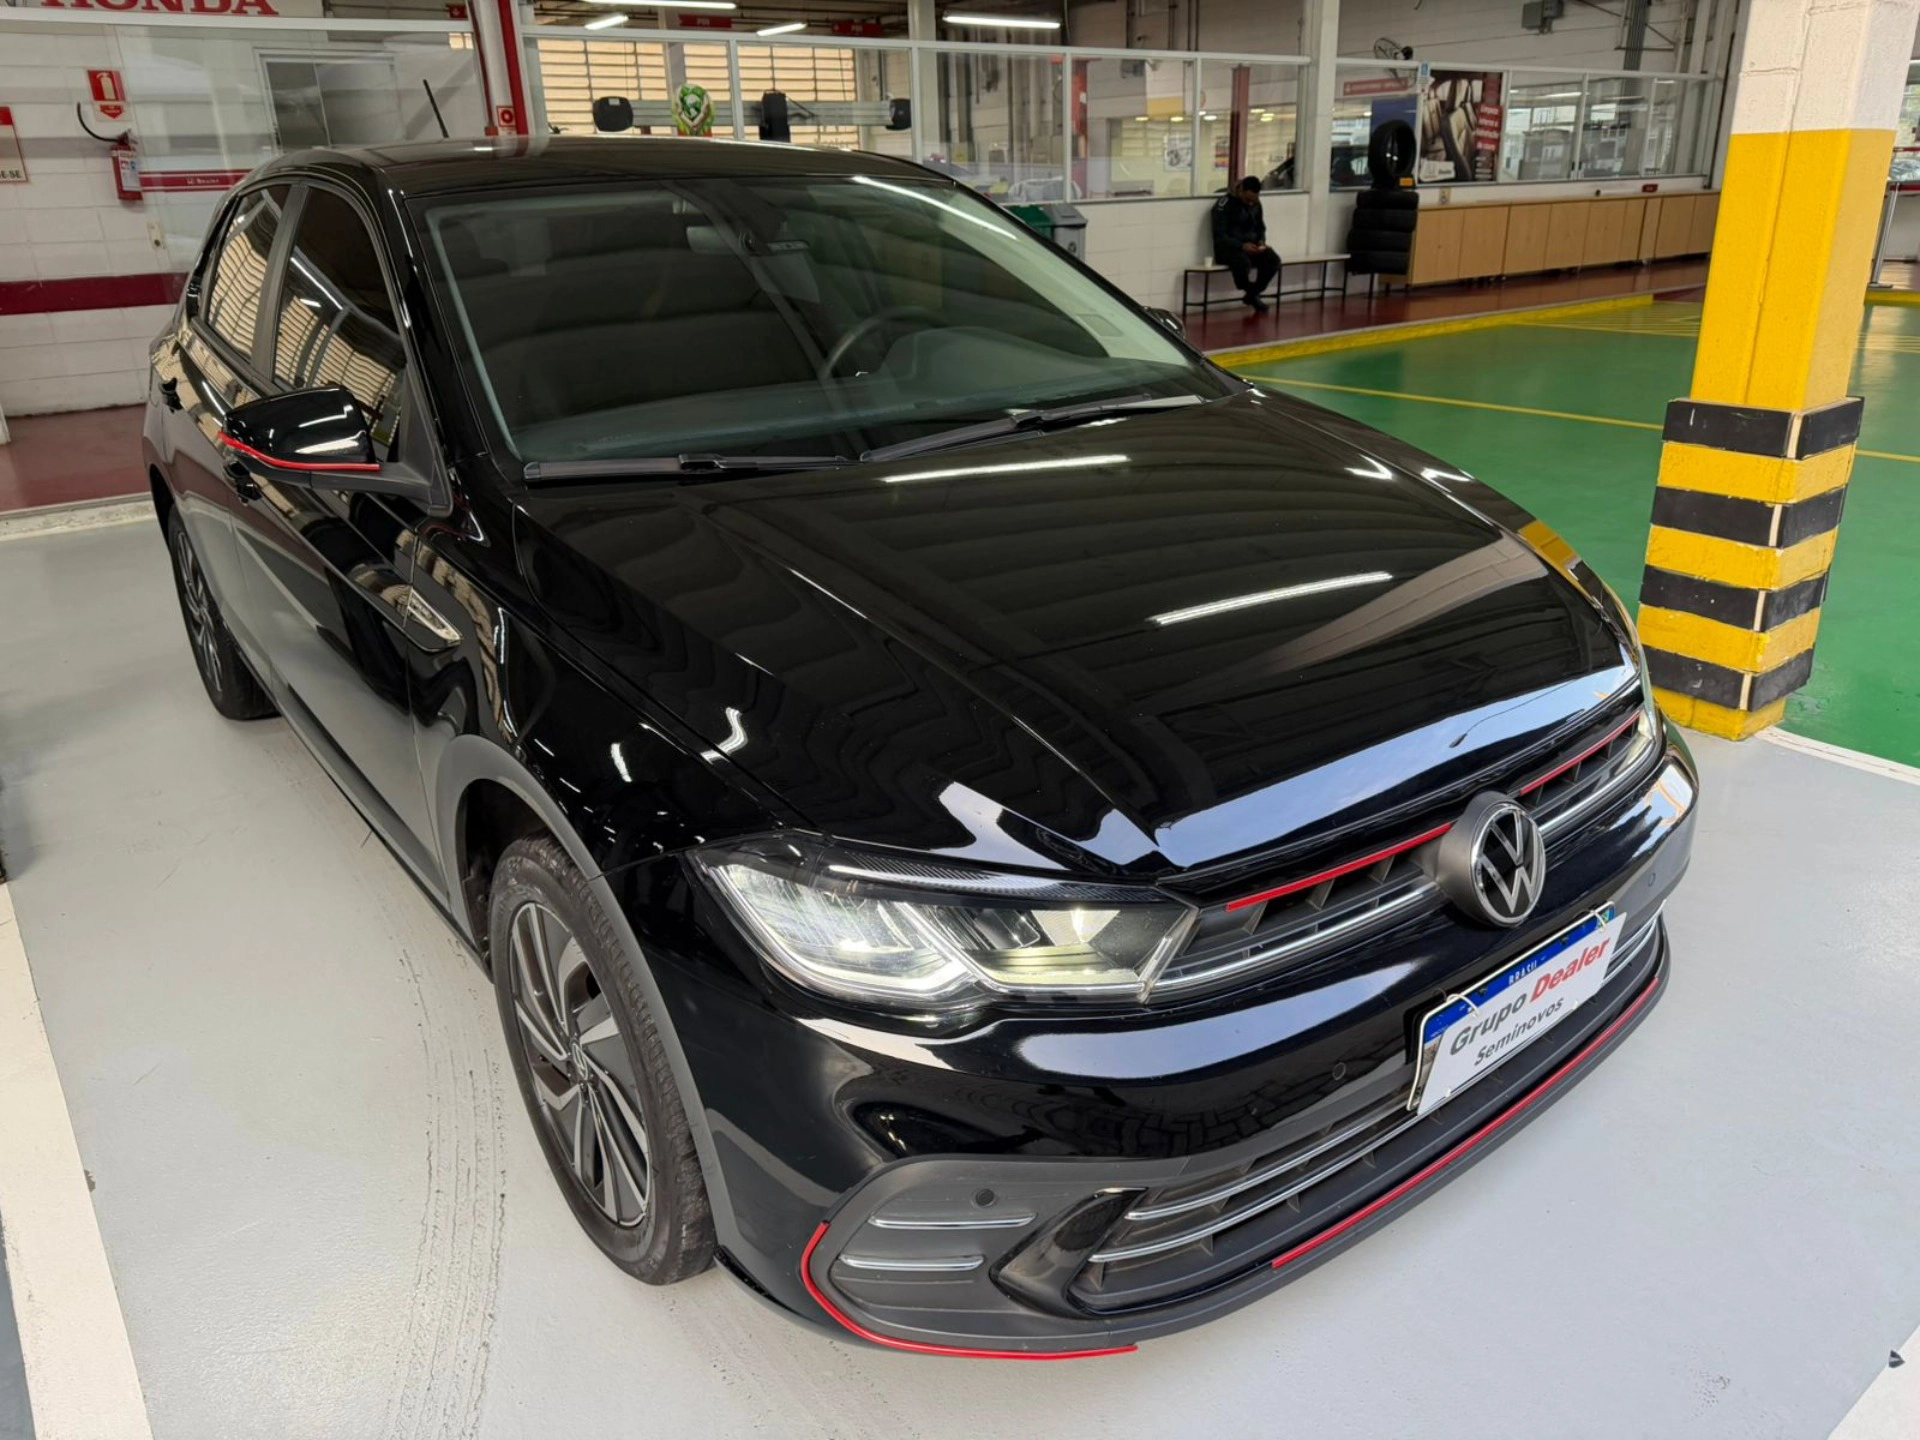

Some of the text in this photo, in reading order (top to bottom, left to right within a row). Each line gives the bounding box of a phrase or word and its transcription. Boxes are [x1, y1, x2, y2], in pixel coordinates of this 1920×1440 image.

[41, 0, 279, 15] NDA
[1450, 937, 1611, 1056] Grupo Dealer
[1474, 997, 1564, 1066] Seminovos
